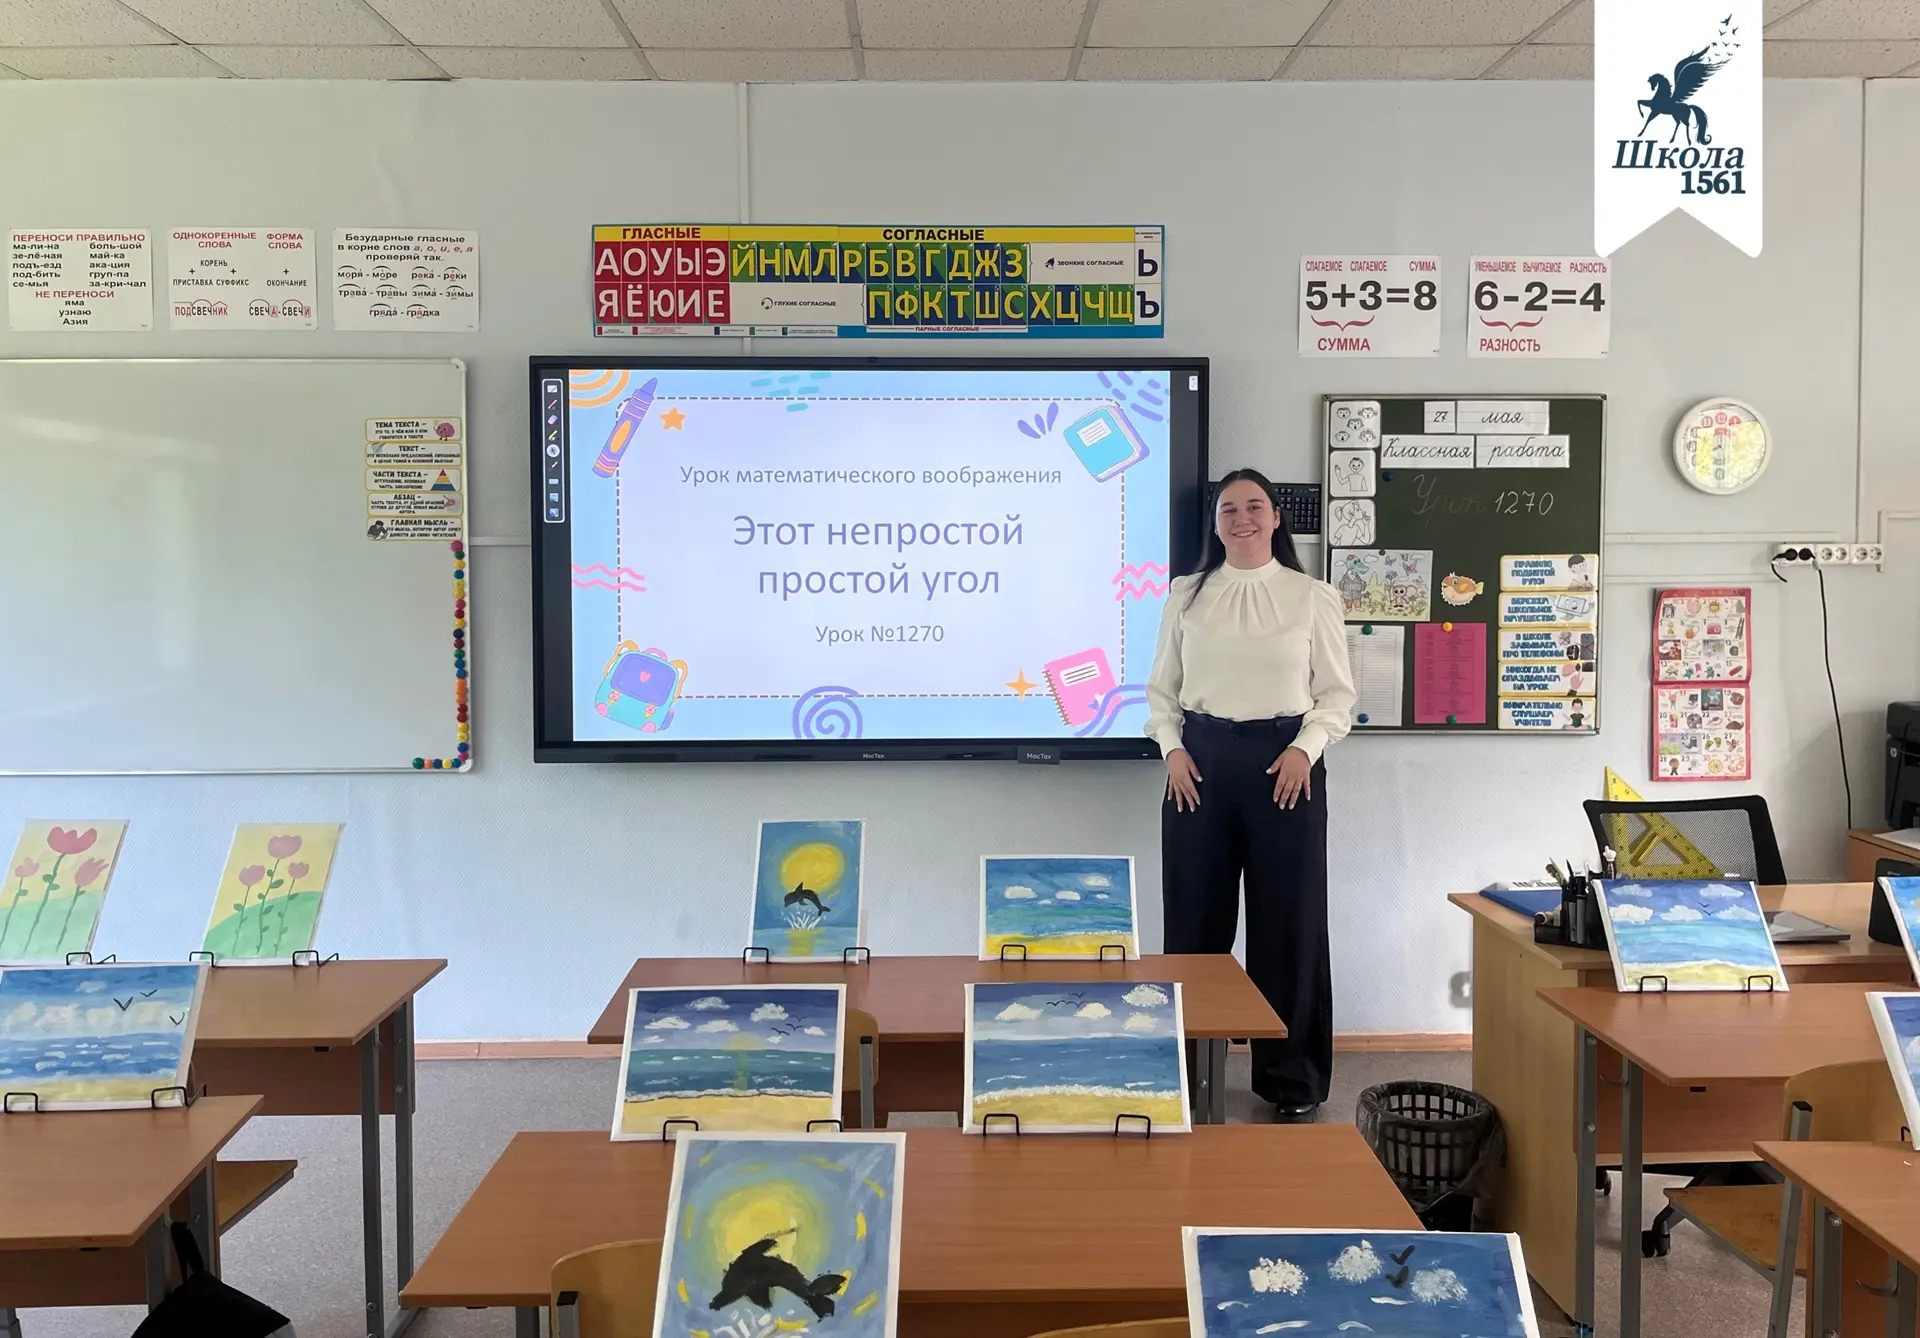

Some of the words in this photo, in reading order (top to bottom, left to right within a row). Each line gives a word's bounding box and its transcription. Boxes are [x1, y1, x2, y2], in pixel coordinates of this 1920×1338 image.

[173, 232, 256, 240] ОДНОКОРЕННЫЕ
[346, 234, 414, 242] Безударные
[622, 228, 700, 239] ГЛАСНЫЕ
[883, 229, 984, 240] СОГЛАСНЫЕ
[1306, 261, 1343, 272] СЛАГАЕМОЕ
[1350, 261, 1387, 272] СЛАГАЕМОЕ
[1409, 261, 1436, 272] СУММА
[1475, 262, 1516, 272] УМЕНЬШАЕМОЕ
[1523, 262, 1561, 272] ВЫЧИТАЕМОЕ
[1570, 263, 1606, 273] РАЗНОСТЬ
[1306, 280, 1437, 310] 5+3=8
[175, 307, 228, 317] ПОДСВЕЧНИК
[1317, 338, 1370, 351] СУММА
[1479, 338, 1540, 352] РАЗНОСТЬ
[1434, 411, 1448, 423] 27
[1481, 412, 1523, 423] мая
[1383, 438, 1472, 458] Классная
[1487, 437, 1565, 465] работа
[680, 466, 729, 487] Урок
[736, 469, 916, 484] математического
[922, 466, 1062, 487] воображения
[1495, 491, 1554, 515] 1270
[733, 515, 815, 546] Этот
[828, 513, 1023, 553] непростой
[759, 562, 909, 600] простой
[922, 569, 999, 600] угол
[815, 625, 864, 646] Урок
[871, 624, 945, 643] №1270
[1521, 650, 1564, 658] ТЕЛЕФОНЫ
